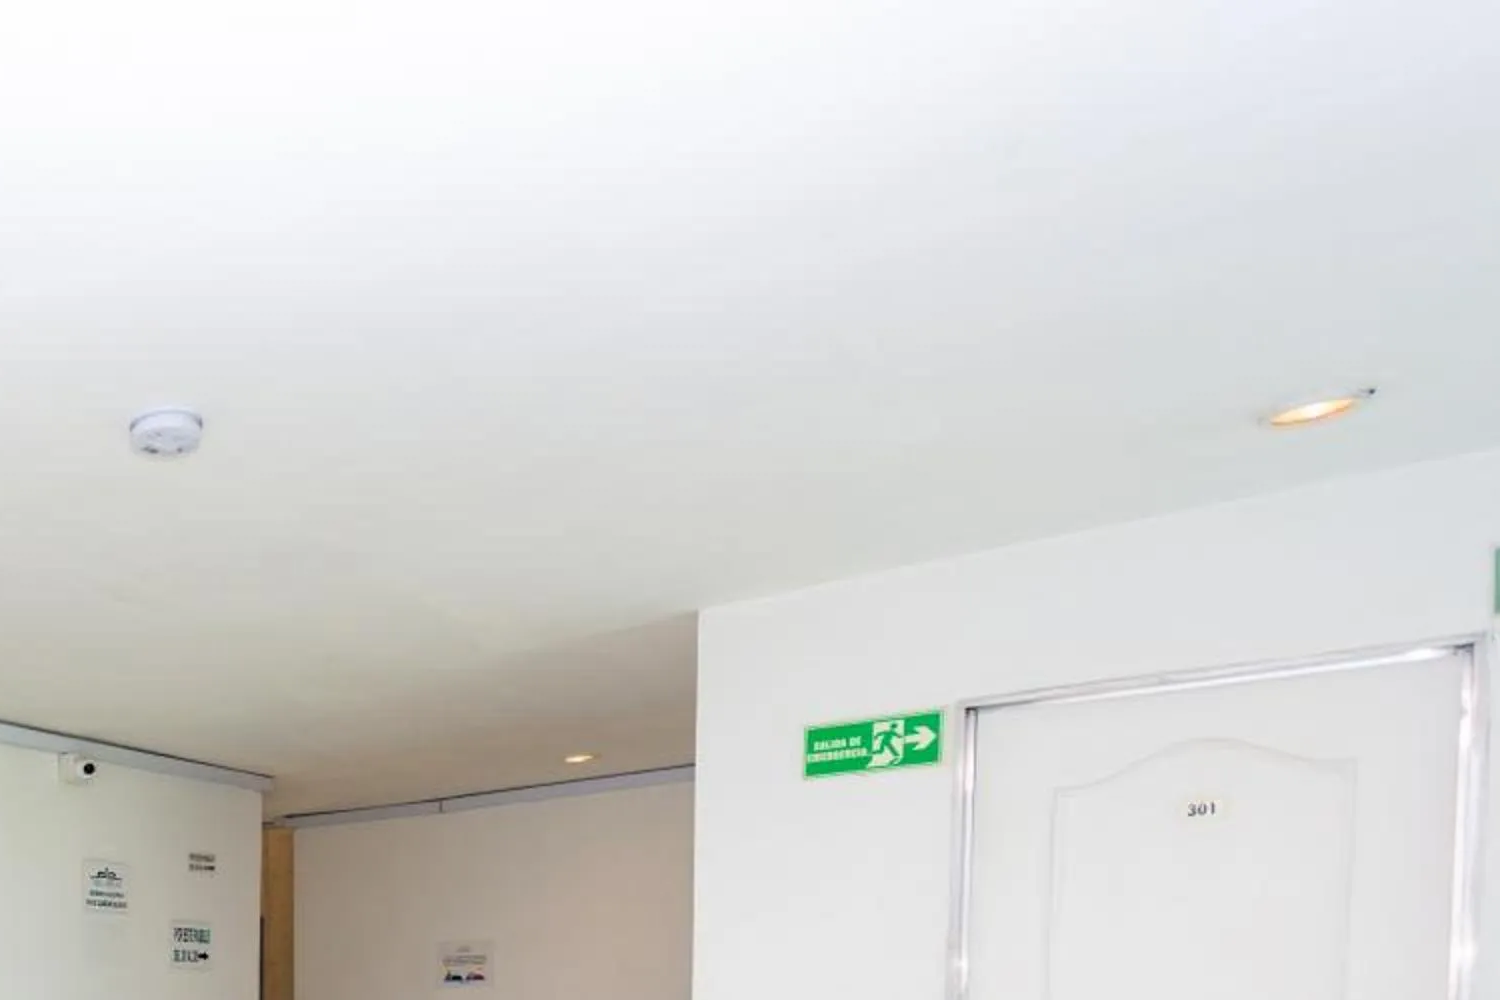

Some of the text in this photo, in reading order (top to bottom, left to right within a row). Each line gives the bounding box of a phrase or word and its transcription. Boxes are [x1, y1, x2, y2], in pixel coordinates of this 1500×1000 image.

[813, 735, 862, 752] SALIDA DE
[807, 747, 868, 763] EMERGENCIA
[1187, 802, 1216, 817] 301
